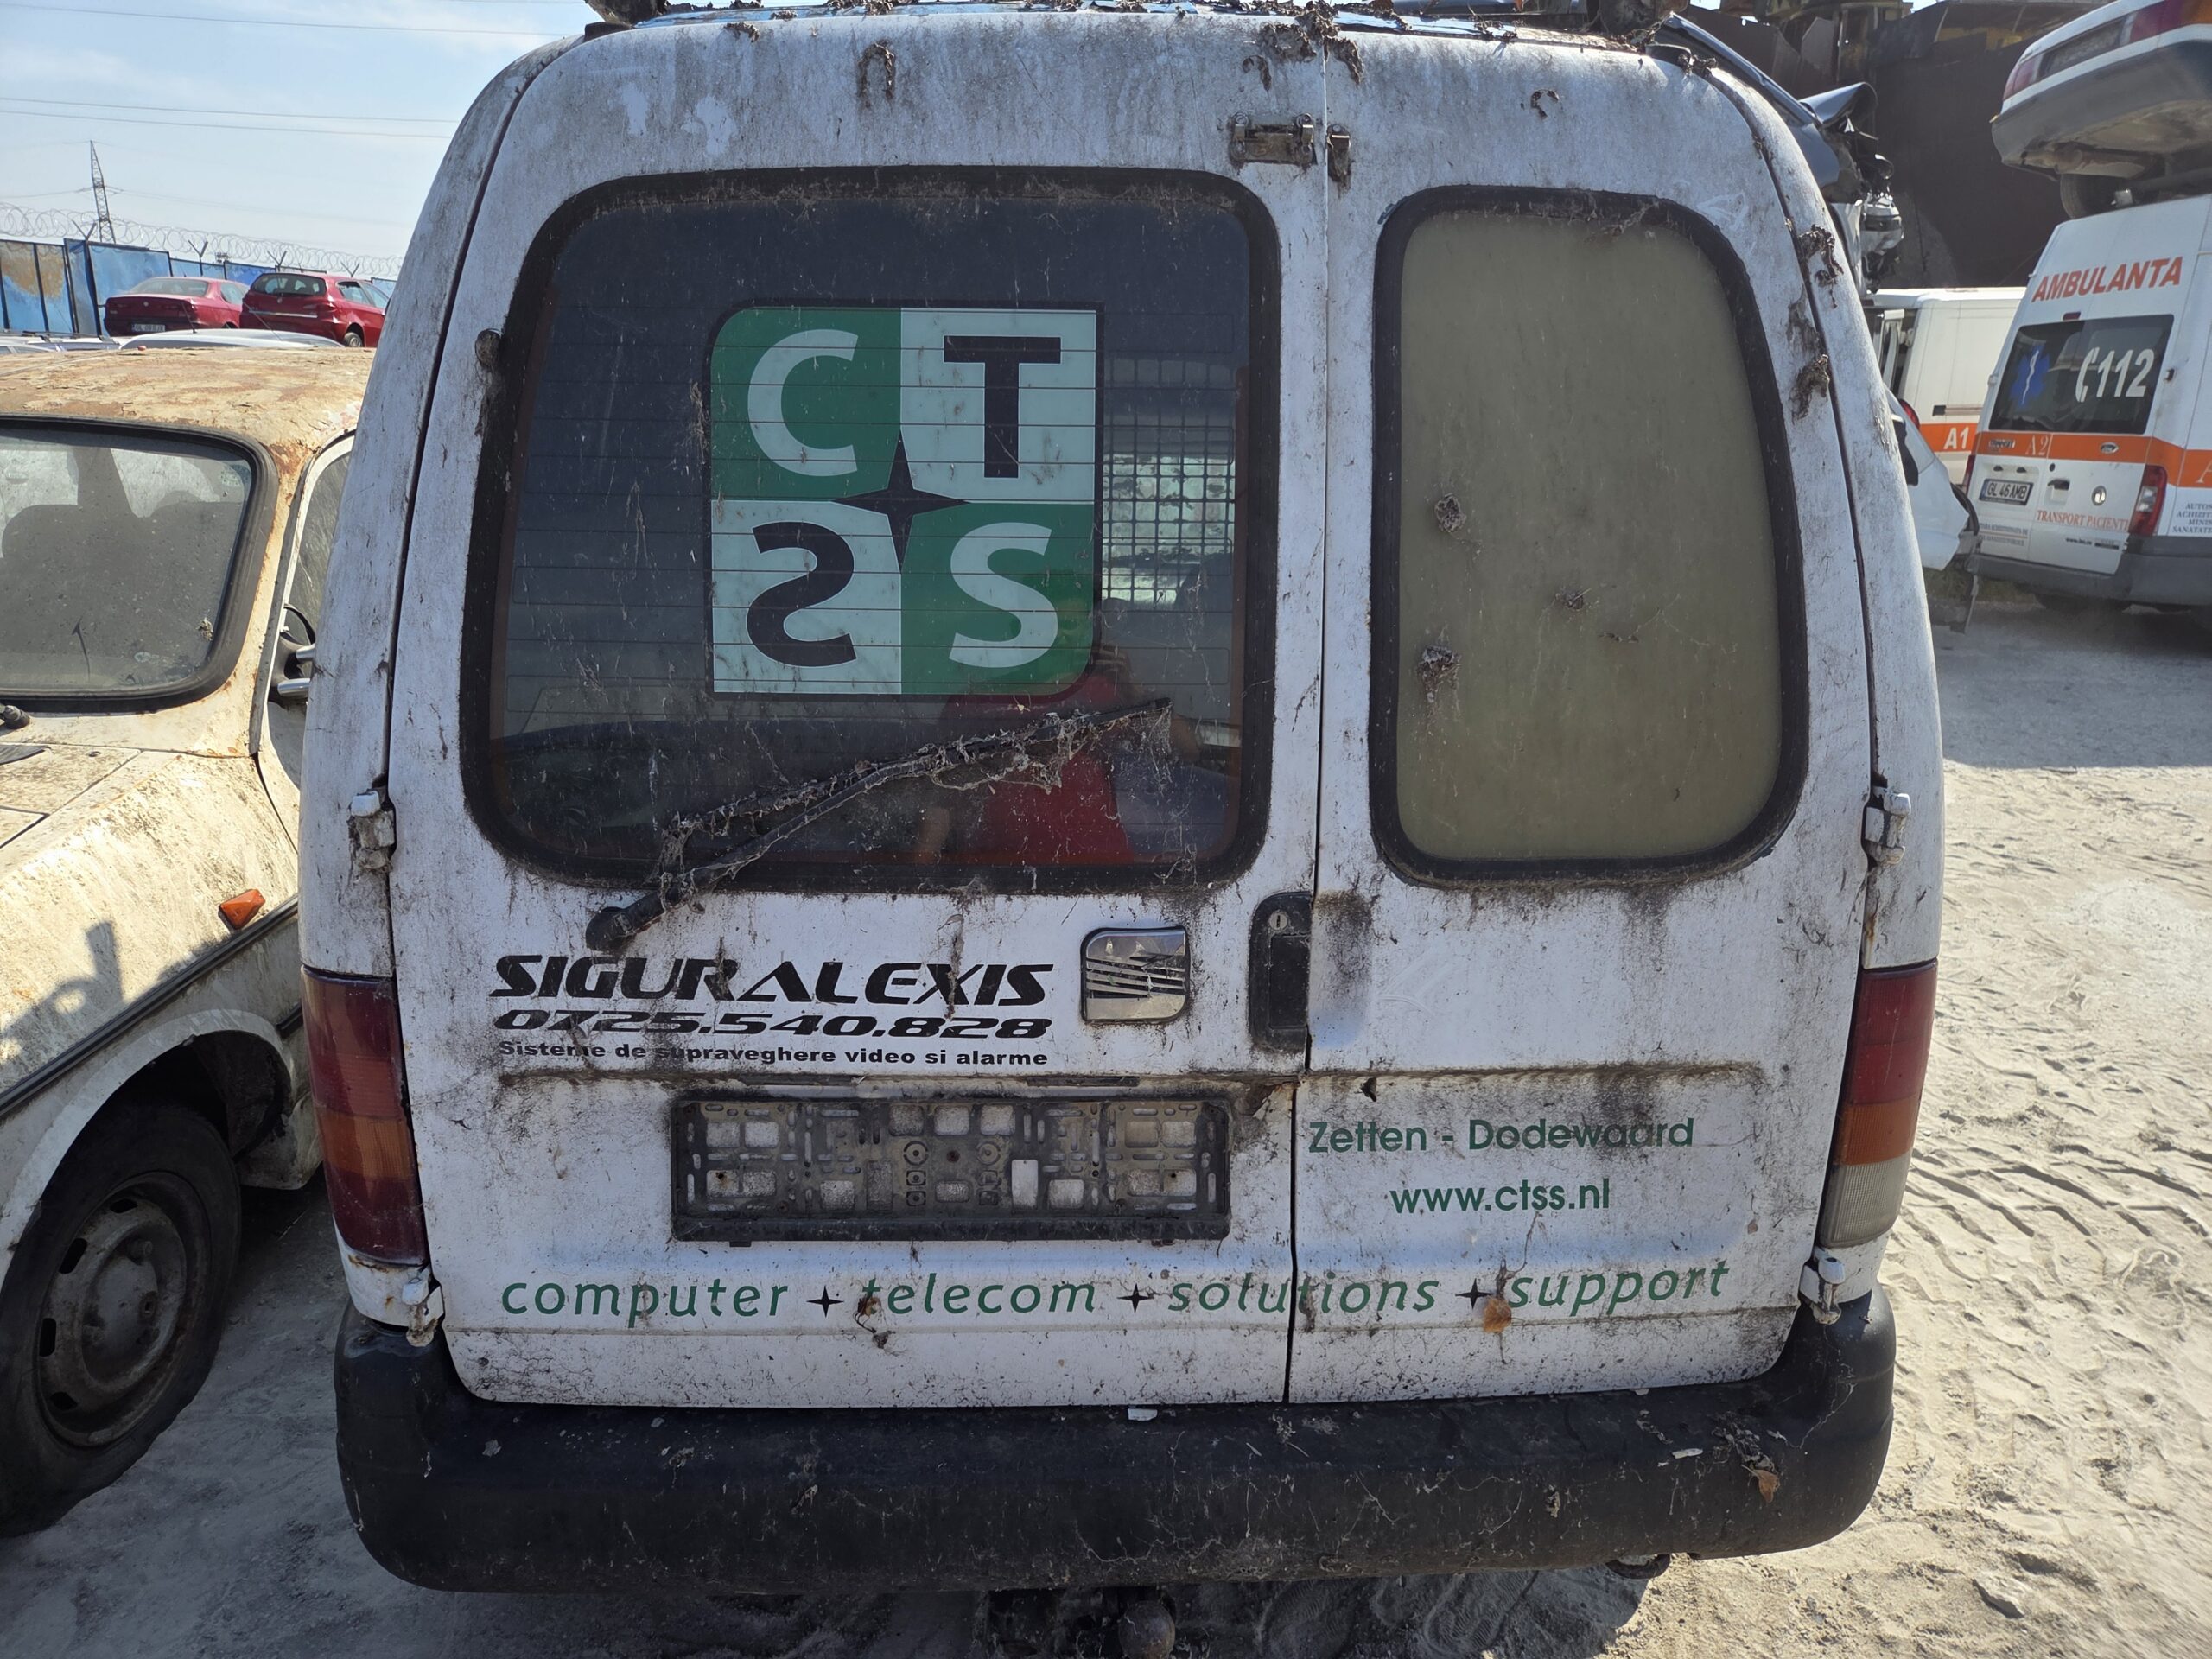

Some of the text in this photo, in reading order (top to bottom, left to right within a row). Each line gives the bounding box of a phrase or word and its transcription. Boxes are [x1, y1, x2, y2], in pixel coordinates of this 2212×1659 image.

[2031, 257, 2183, 302] AMBULANTA
[2097, 348, 2155, 397] 112
[1943, 428, 1969, 449] A1
[2025, 435, 2049, 456] A2
[2037, 510, 2129, 531] TRANSPORT PACIENTI
[489, 955, 1054, 1007] SIGURALEXIS
[493, 1008, 1053, 1039] 0725.540.828
[499, 1041, 1049, 1066] Sisteme de supraveghere video si alarme
[1308, 1120, 1427, 1154] Zetten
[1469, 1117, 1695, 1151] Dodewaard
[1389, 1178, 1610, 1214] www.ctss.nl
[501, 1260, 1730, 1328] computer telecom solutions support
